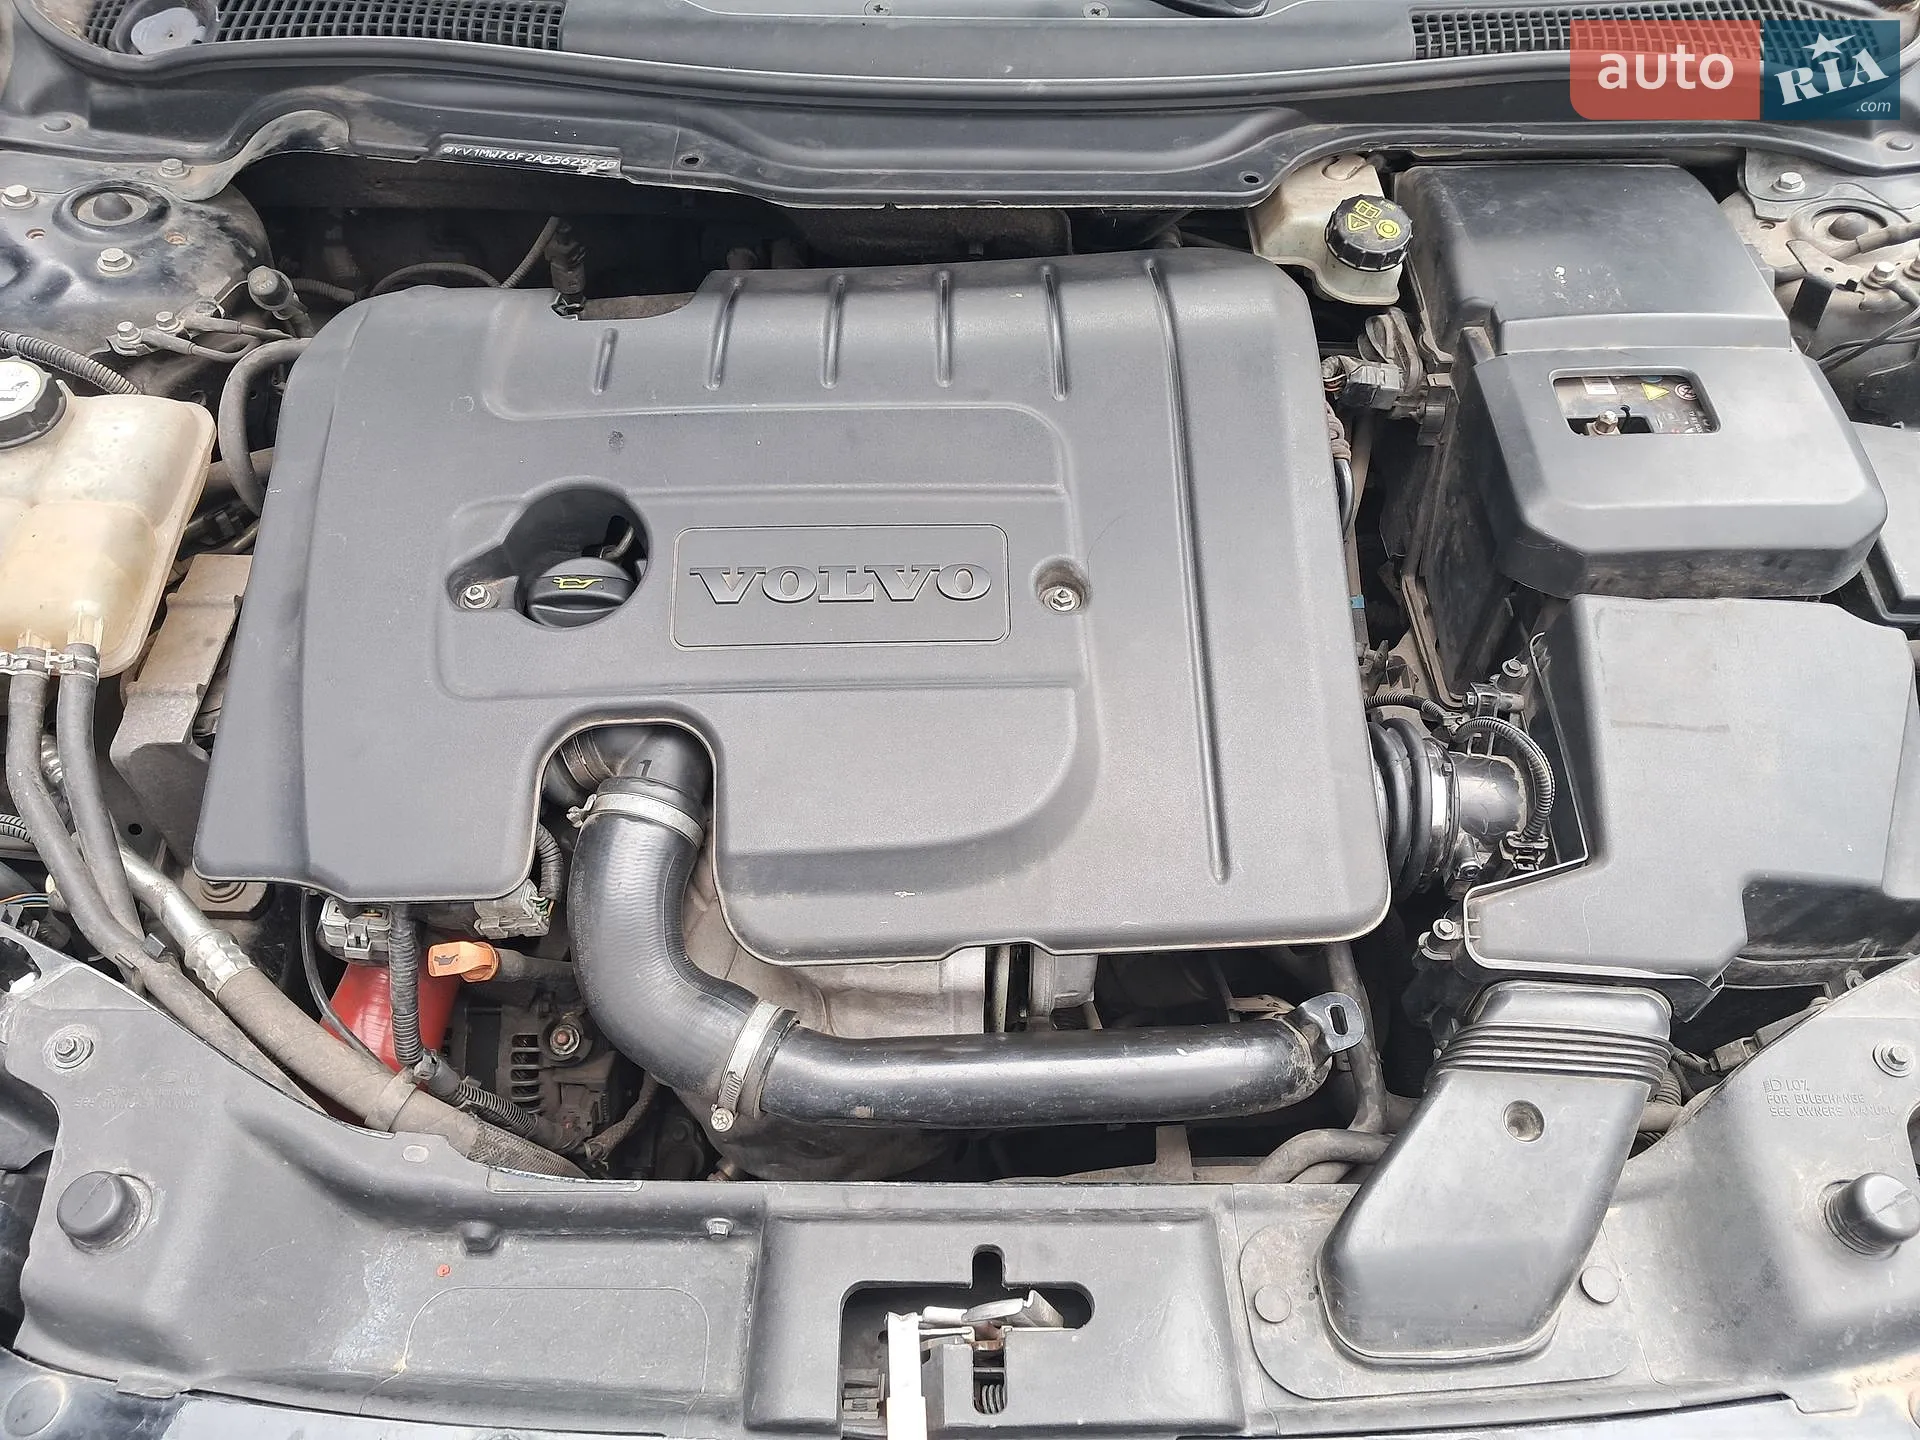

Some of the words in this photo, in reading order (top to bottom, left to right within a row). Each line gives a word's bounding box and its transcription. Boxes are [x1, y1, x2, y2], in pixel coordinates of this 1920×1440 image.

[689, 563, 991, 604] VOLVO
[1767, 1094, 1789, 1104] FOR
[1769, 1106, 1791, 1117] SEE
